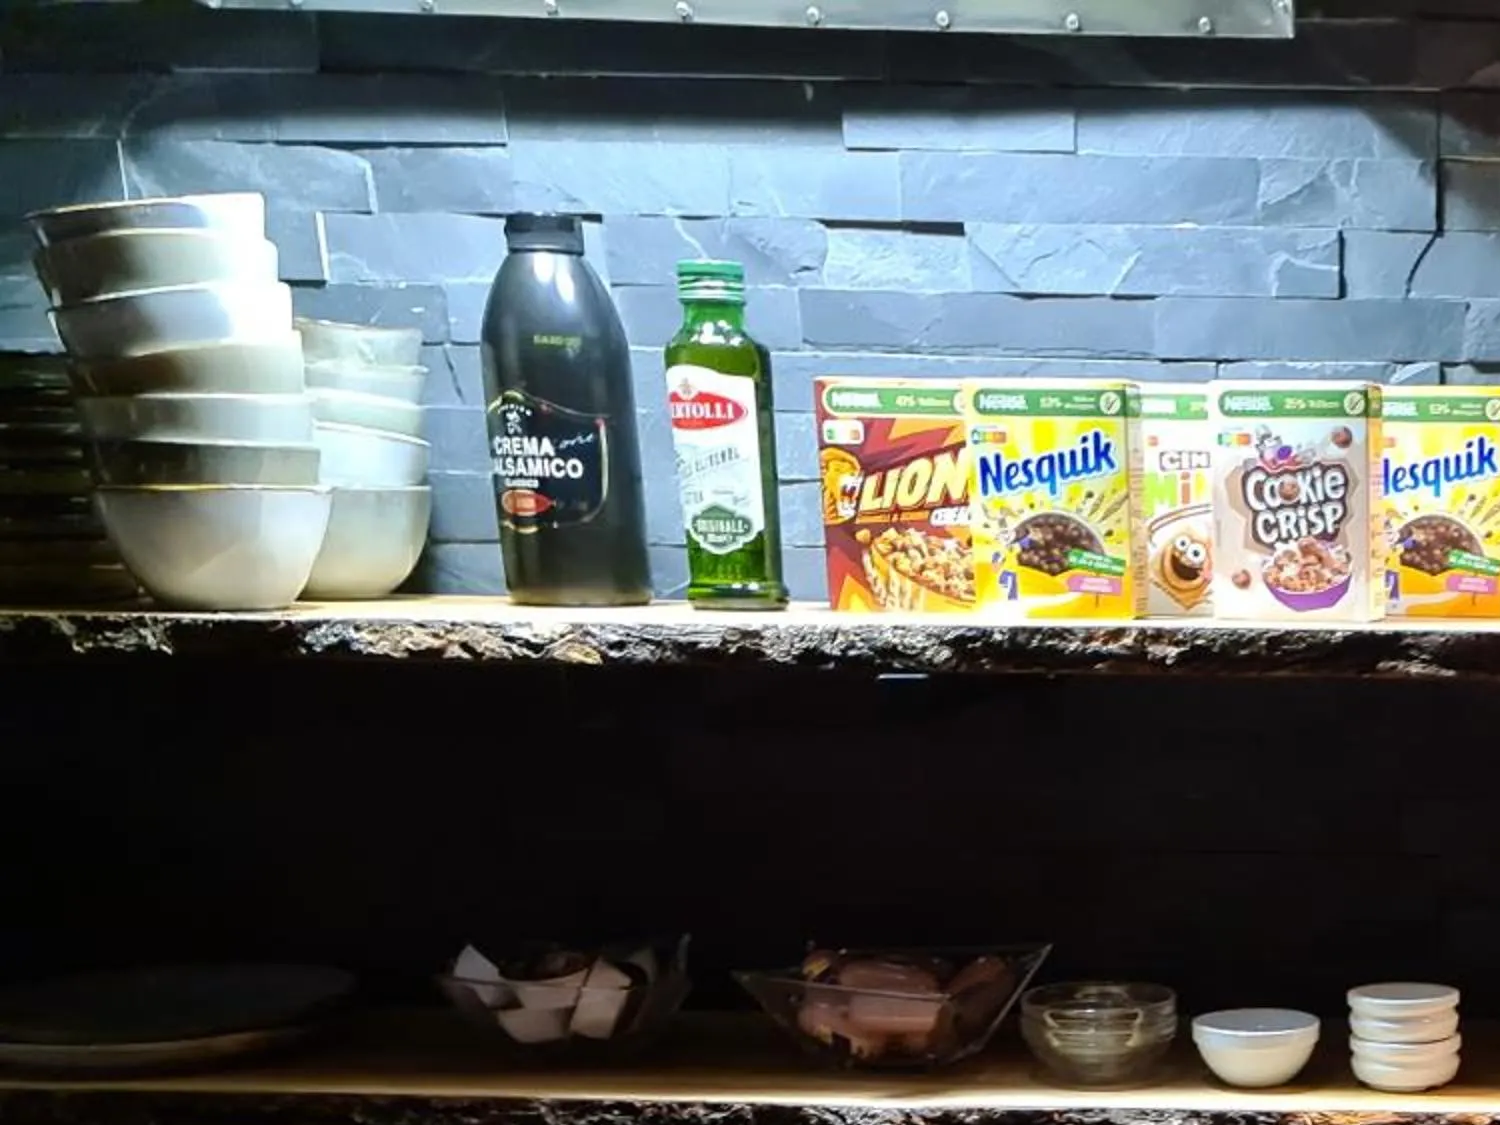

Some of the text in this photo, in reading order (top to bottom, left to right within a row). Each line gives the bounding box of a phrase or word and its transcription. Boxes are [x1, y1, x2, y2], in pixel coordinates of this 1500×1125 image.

[493, 436, 556, 456] CREMA
[979, 431, 1117, 497] Nesquik
[1160, 451, 1211, 471] CIN
[1383, 436, 1498, 498] esquik
[493, 457, 584, 479] ALSAMICO
[859, 445, 969, 512] LION
